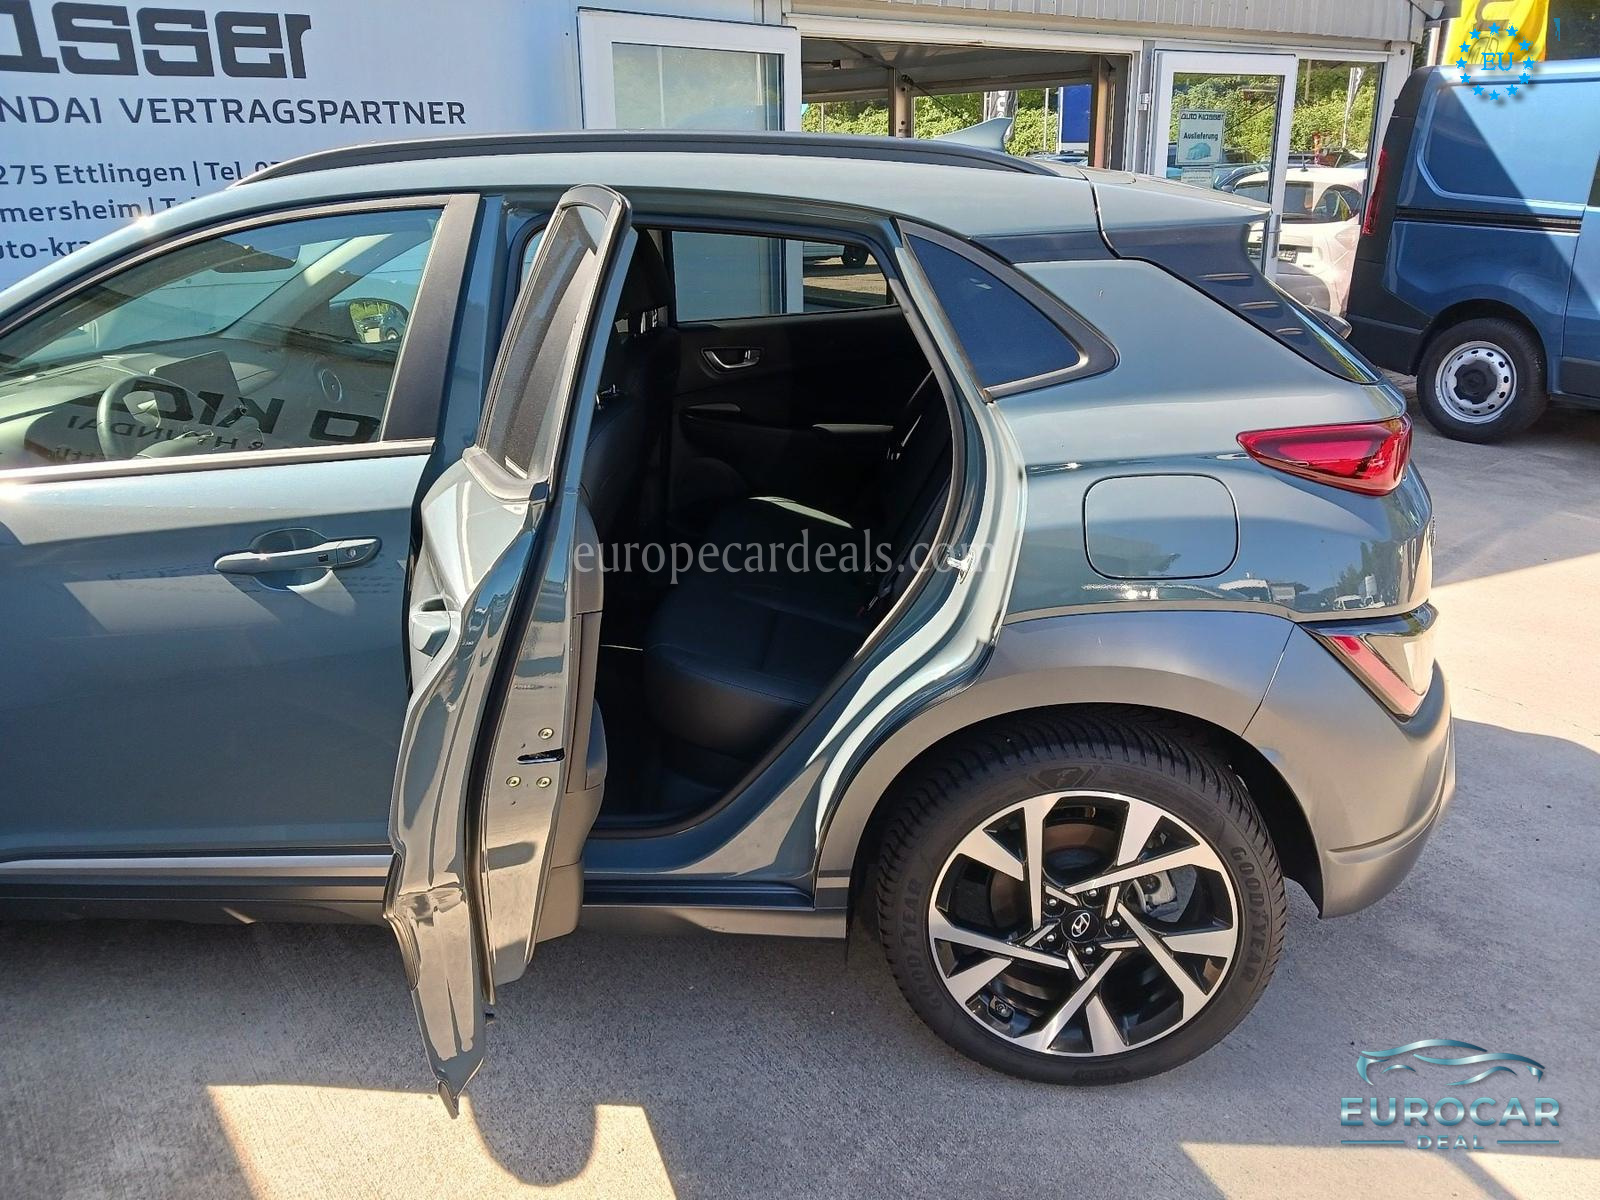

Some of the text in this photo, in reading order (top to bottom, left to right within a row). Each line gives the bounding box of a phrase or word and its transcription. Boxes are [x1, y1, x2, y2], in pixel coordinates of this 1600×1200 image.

[119, 97, 466, 125] VERTRAGSPARTNER
[1183, 131, 1219, 141] Auslieferung
[53, 161, 186, 187] Ettlingen
[203, 161, 246, 181] Tel
[0, 199, 143, 223] mersheim
